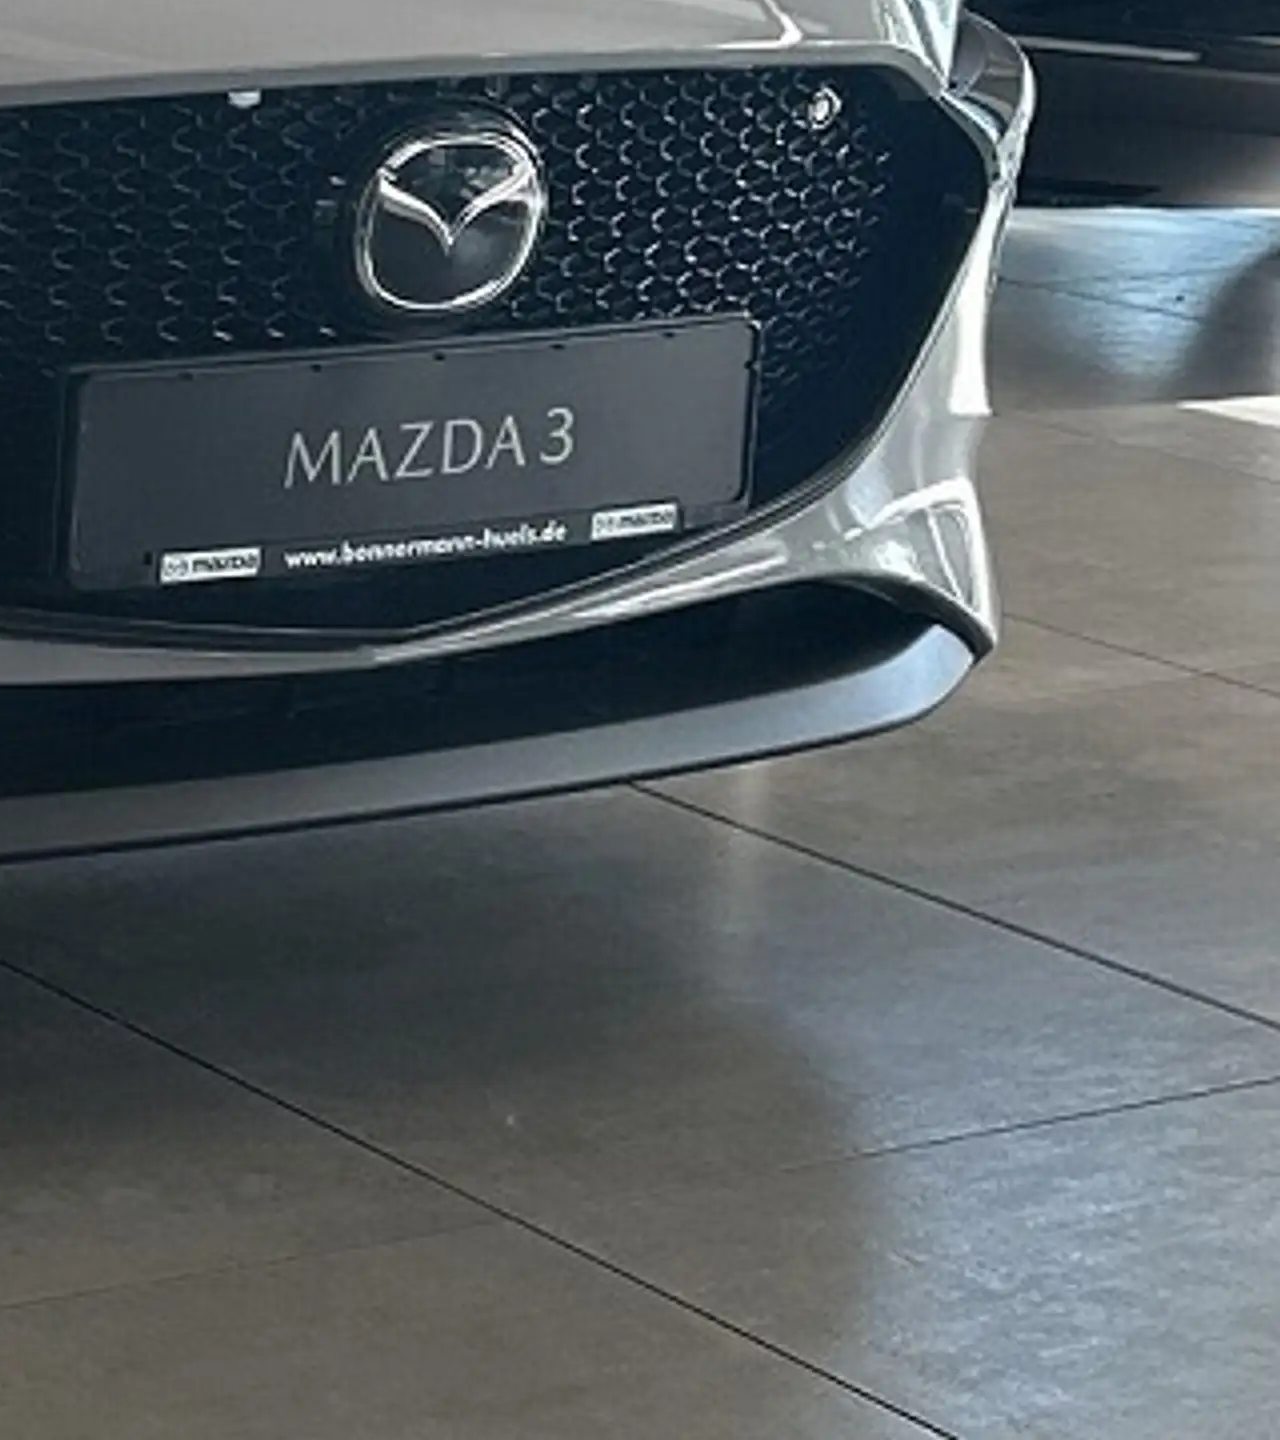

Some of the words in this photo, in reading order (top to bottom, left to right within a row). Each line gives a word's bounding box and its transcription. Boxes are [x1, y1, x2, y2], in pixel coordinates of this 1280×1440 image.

[283, 414, 527, 489] MAZDA
[539, 406, 576, 465] 3
[284, 520, 568, 569] www.bonnermann-huels.de
